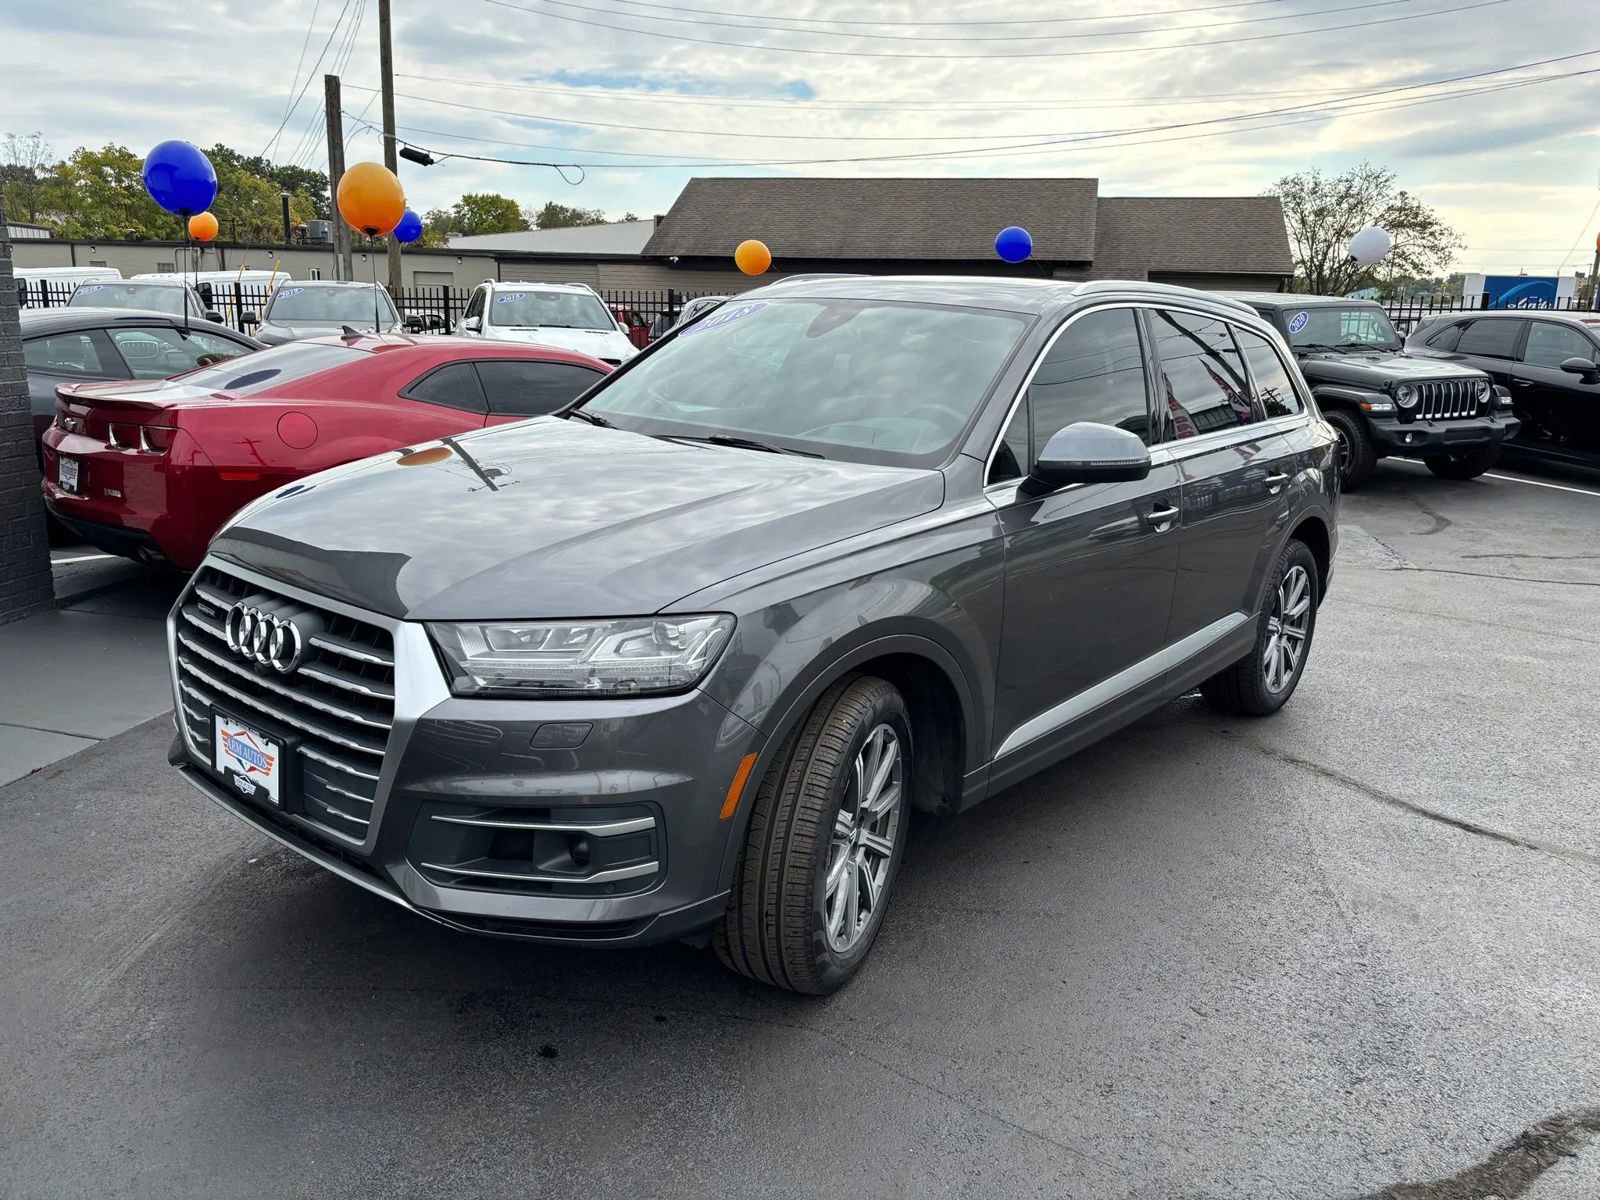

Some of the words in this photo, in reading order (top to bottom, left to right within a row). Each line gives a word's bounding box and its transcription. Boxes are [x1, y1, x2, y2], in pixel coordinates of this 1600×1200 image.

[1291, 313, 1305, 330] 2020
[227, 737, 242, 756] ARM
[242, 746, 266, 769] AUTOS
